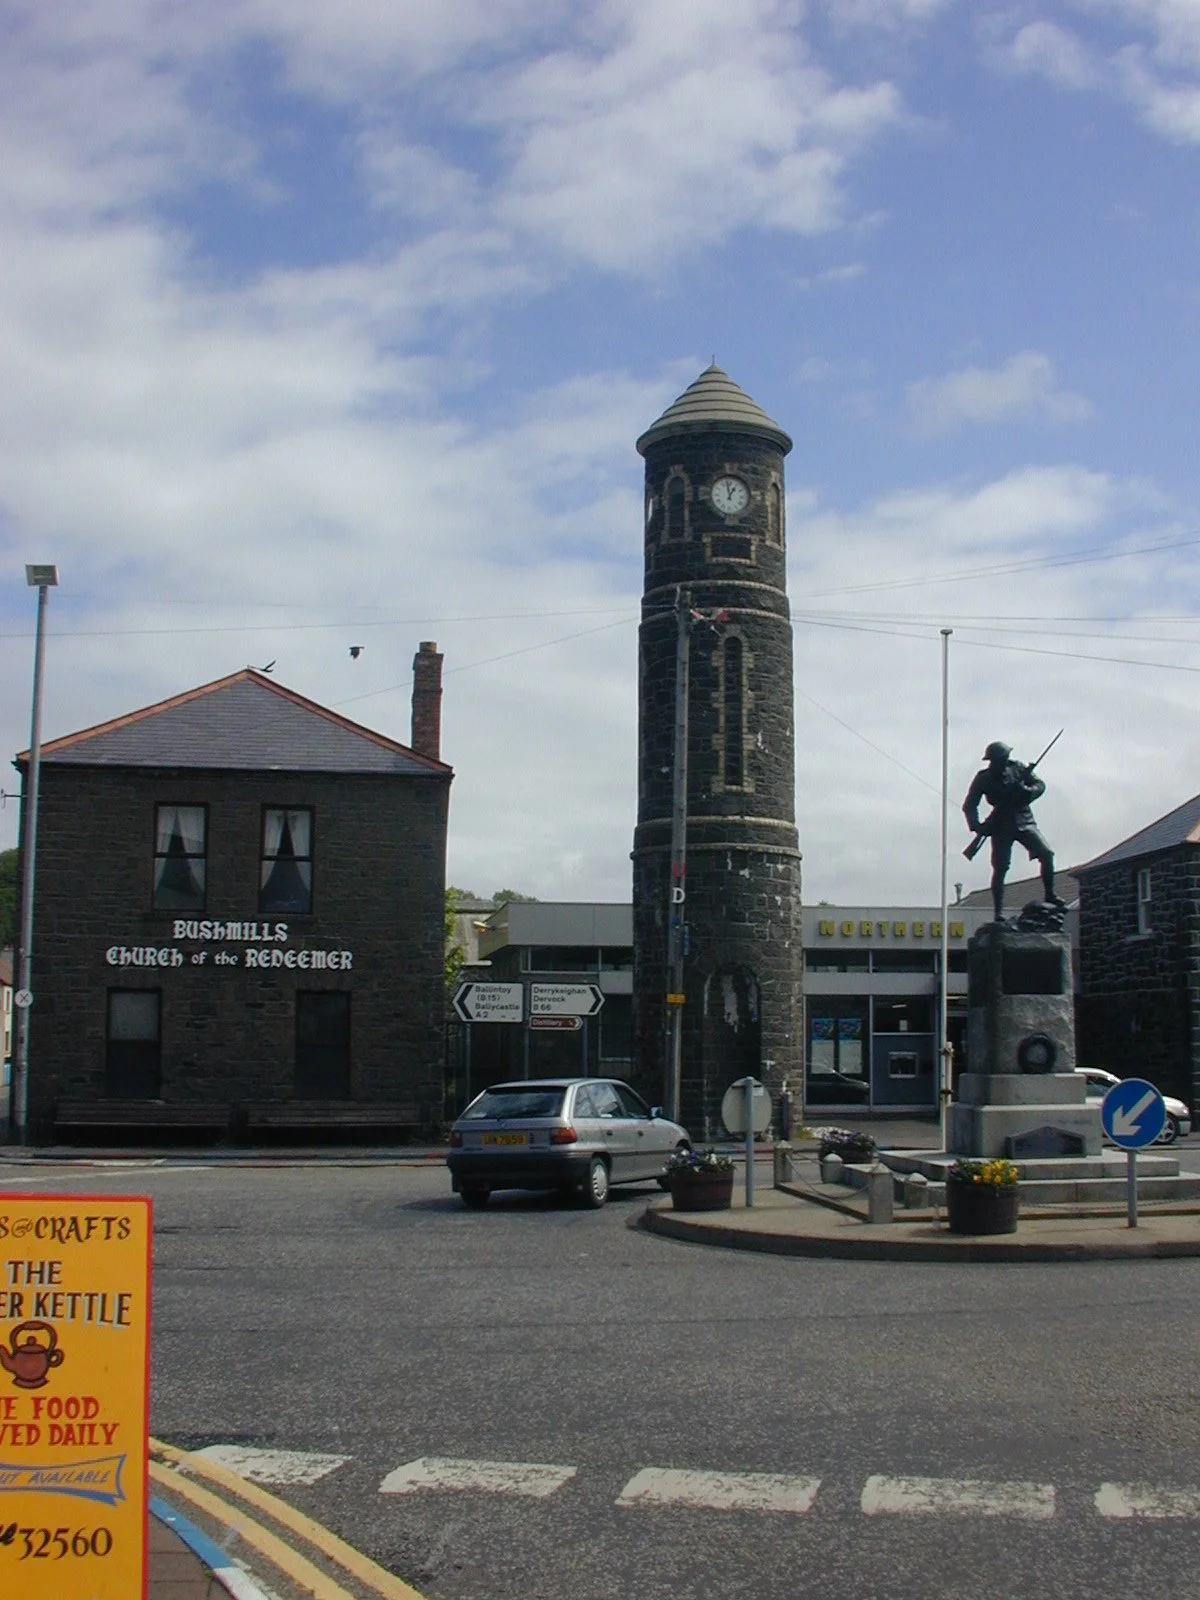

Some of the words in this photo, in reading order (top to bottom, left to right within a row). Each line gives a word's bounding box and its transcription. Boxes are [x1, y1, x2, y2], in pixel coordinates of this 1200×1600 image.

[173, 920, 288, 942] BUSHMILLS
[819, 920, 965, 938] NORTHERN
[106, 946, 183, 967] CHURCH
[191, 951, 206, 965] of
[214, 951, 239, 965] the
[245, 948, 353, 970] REDEEMER
[475, 1003, 520, 1011] Ballycastle
[532, 1018, 563, 1027] Distillery
[35, 1215, 131, 1244] CRAFTS
[6, 1260, 62, 1287] THE
[33, 1291, 132, 1329] KETTLE
[30, 1396, 100, 1420] FOOD
[48, 1423, 120, 1446] DAILY
[28, 1469, 111, 1485] AVAILABLE
[17, 1526, 113, 1561] 32560
